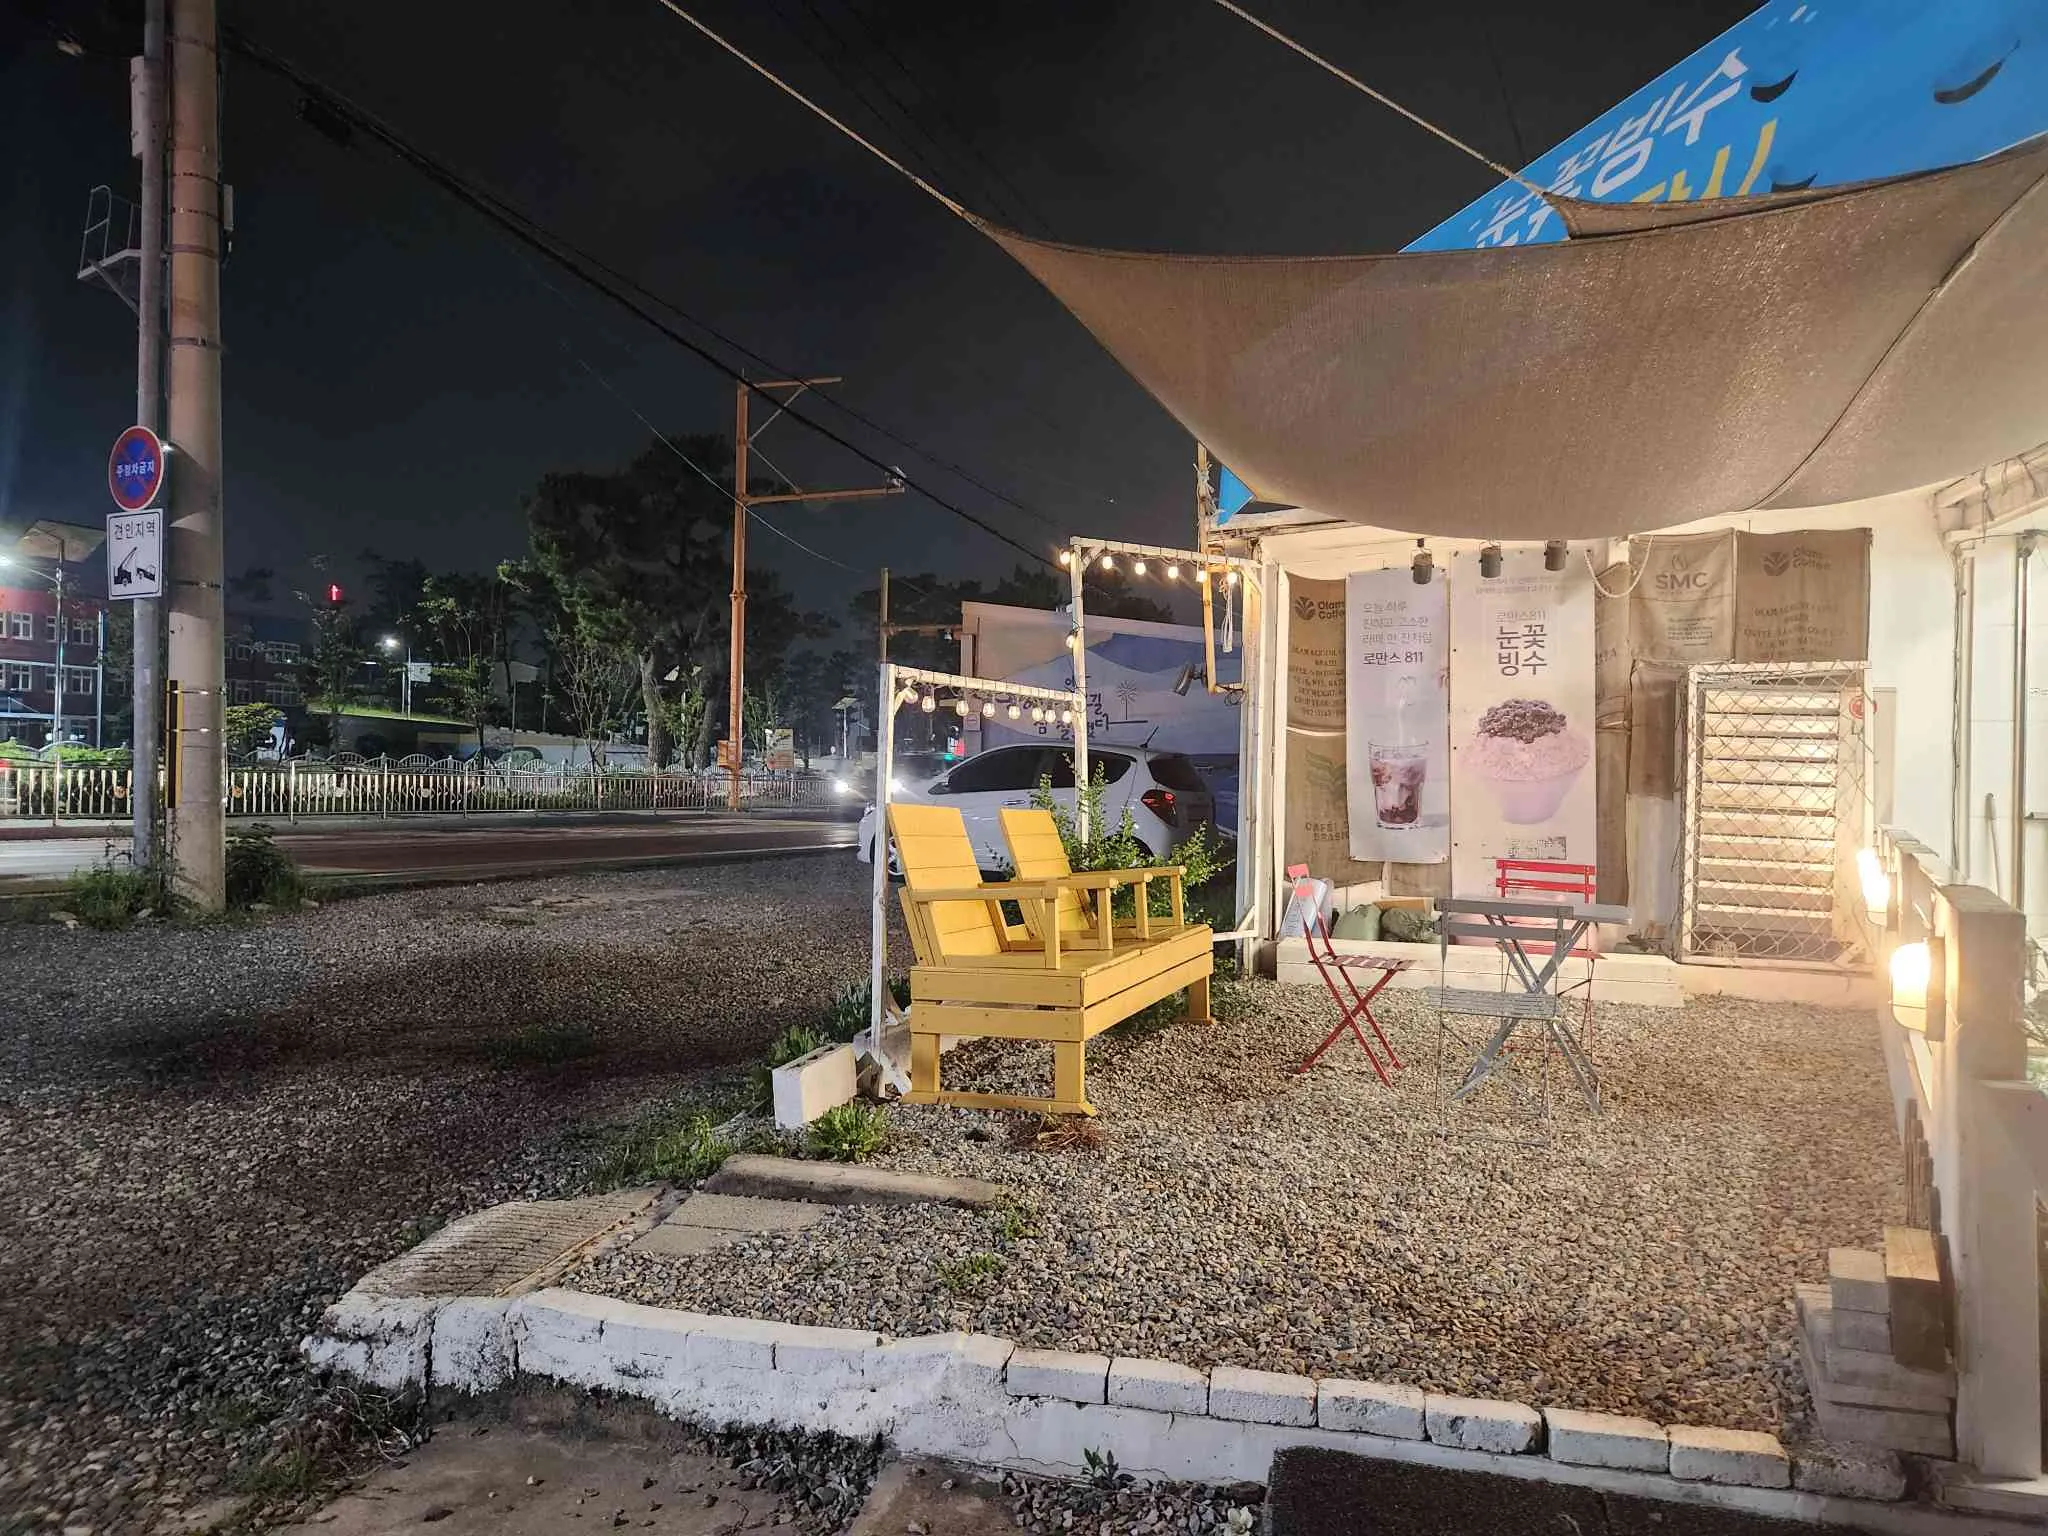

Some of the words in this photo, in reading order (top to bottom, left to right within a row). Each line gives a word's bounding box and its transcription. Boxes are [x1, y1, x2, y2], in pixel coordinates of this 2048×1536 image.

[114, 518, 156, 541] 견인지역
[1655, 572, 1708, 590] SMC
[1496, 624, 1548, 650] 눈꽃
[1404, 651, 1425, 664] 811
[1498, 650, 1548, 677] 빙수
